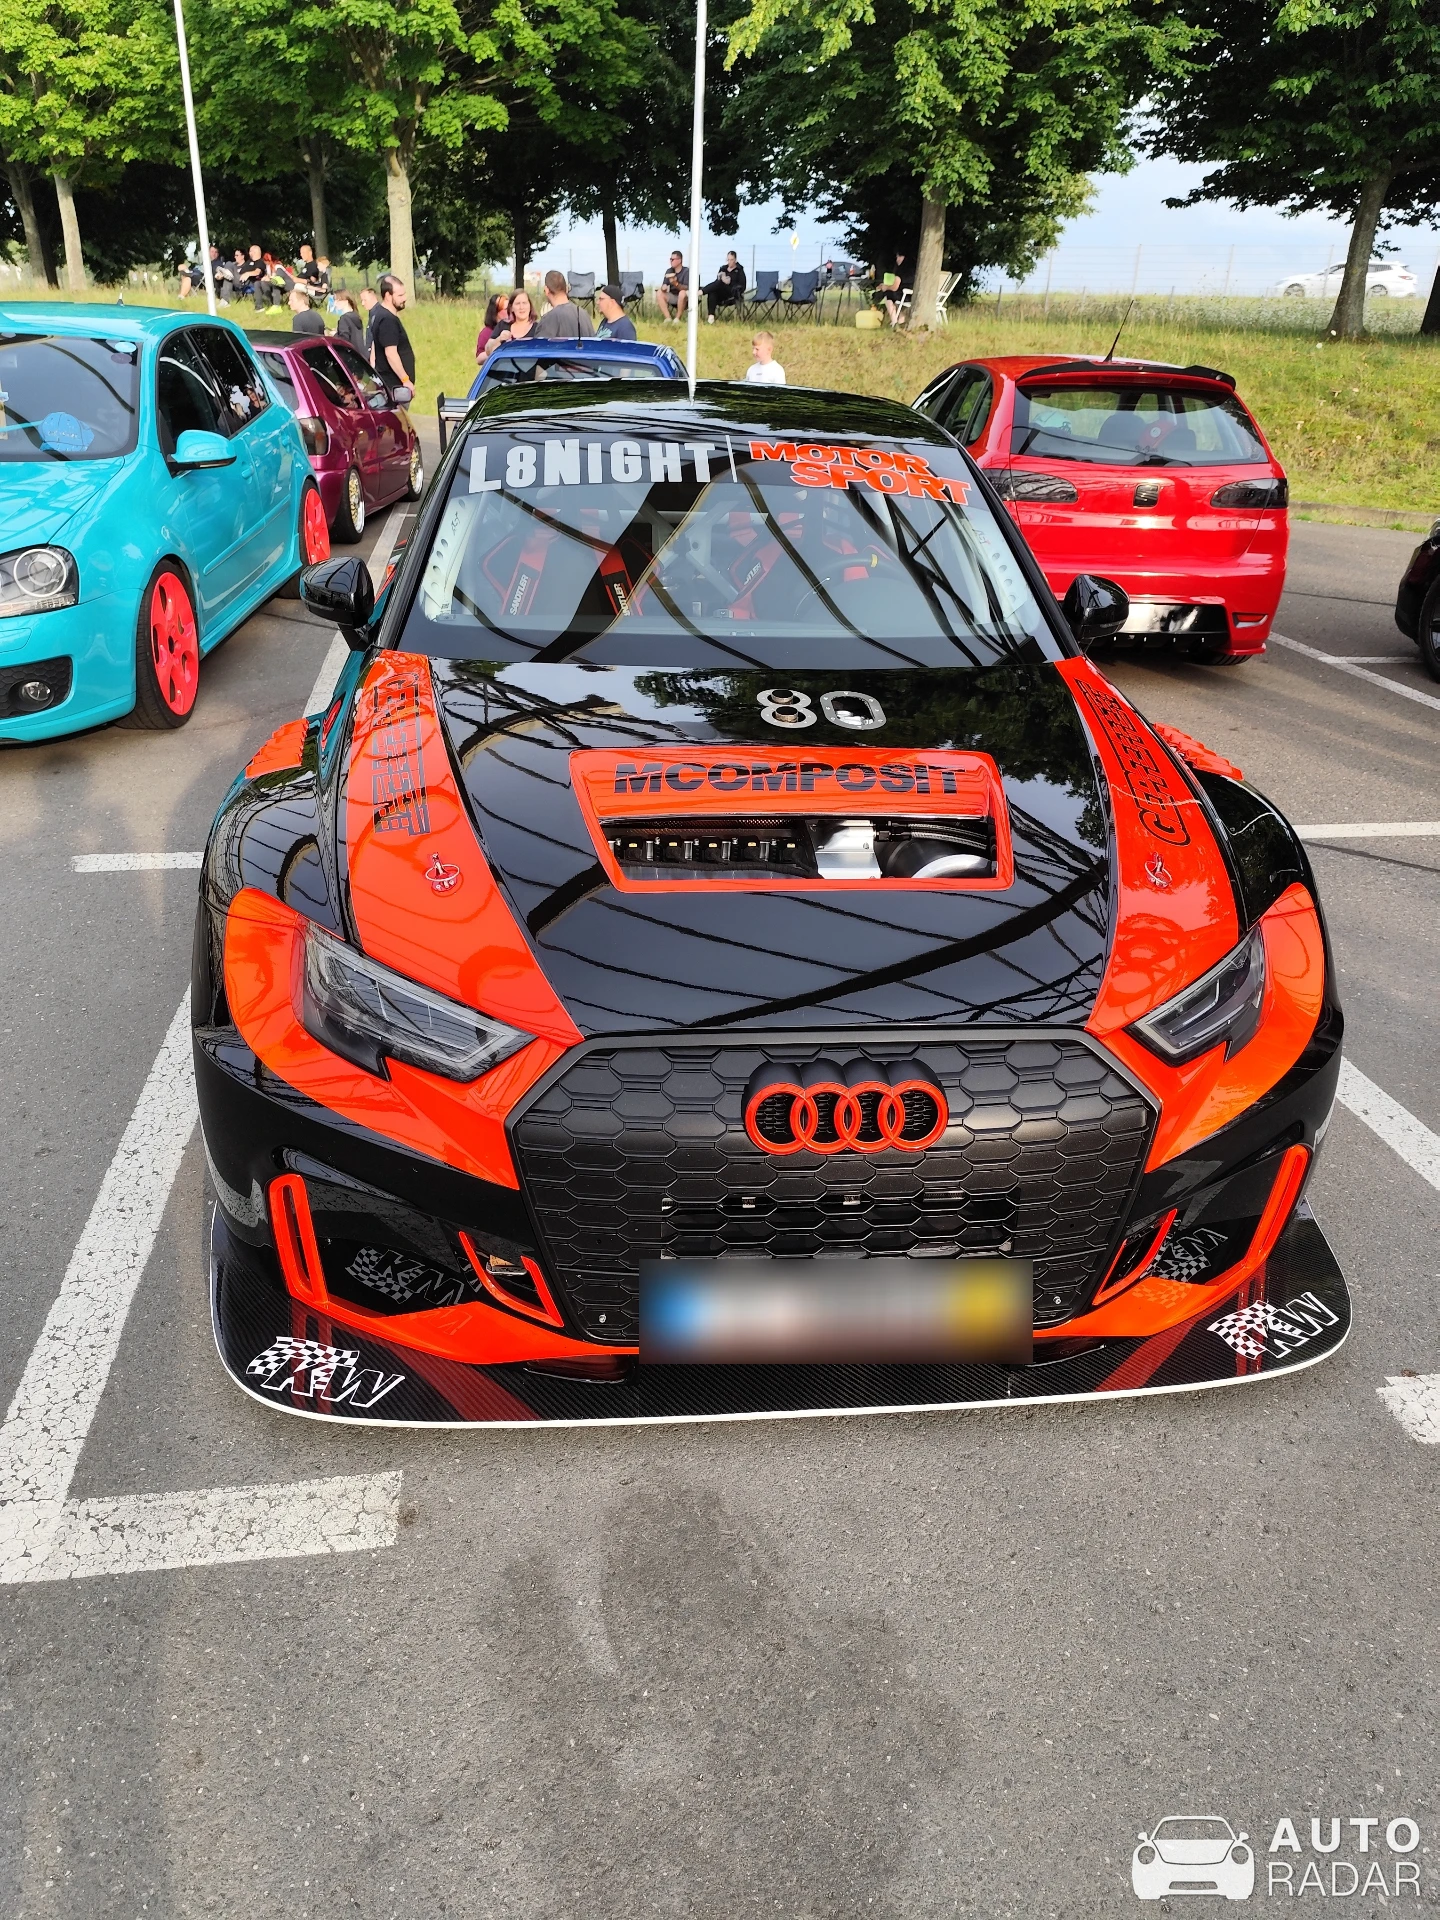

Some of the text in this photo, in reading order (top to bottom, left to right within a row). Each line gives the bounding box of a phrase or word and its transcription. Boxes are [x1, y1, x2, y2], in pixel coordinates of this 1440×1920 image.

[469, 438, 716, 494] L8NIGHT
[748, 440, 936, 477] MOTOR
[790, 461, 972, 506] SPORT
[756, 688, 888, 731] 80
[613, 762, 967, 795] MCOMPOSIT
[1245, 1291, 1340, 1359] KW
[260, 1354, 406, 1408] KW
